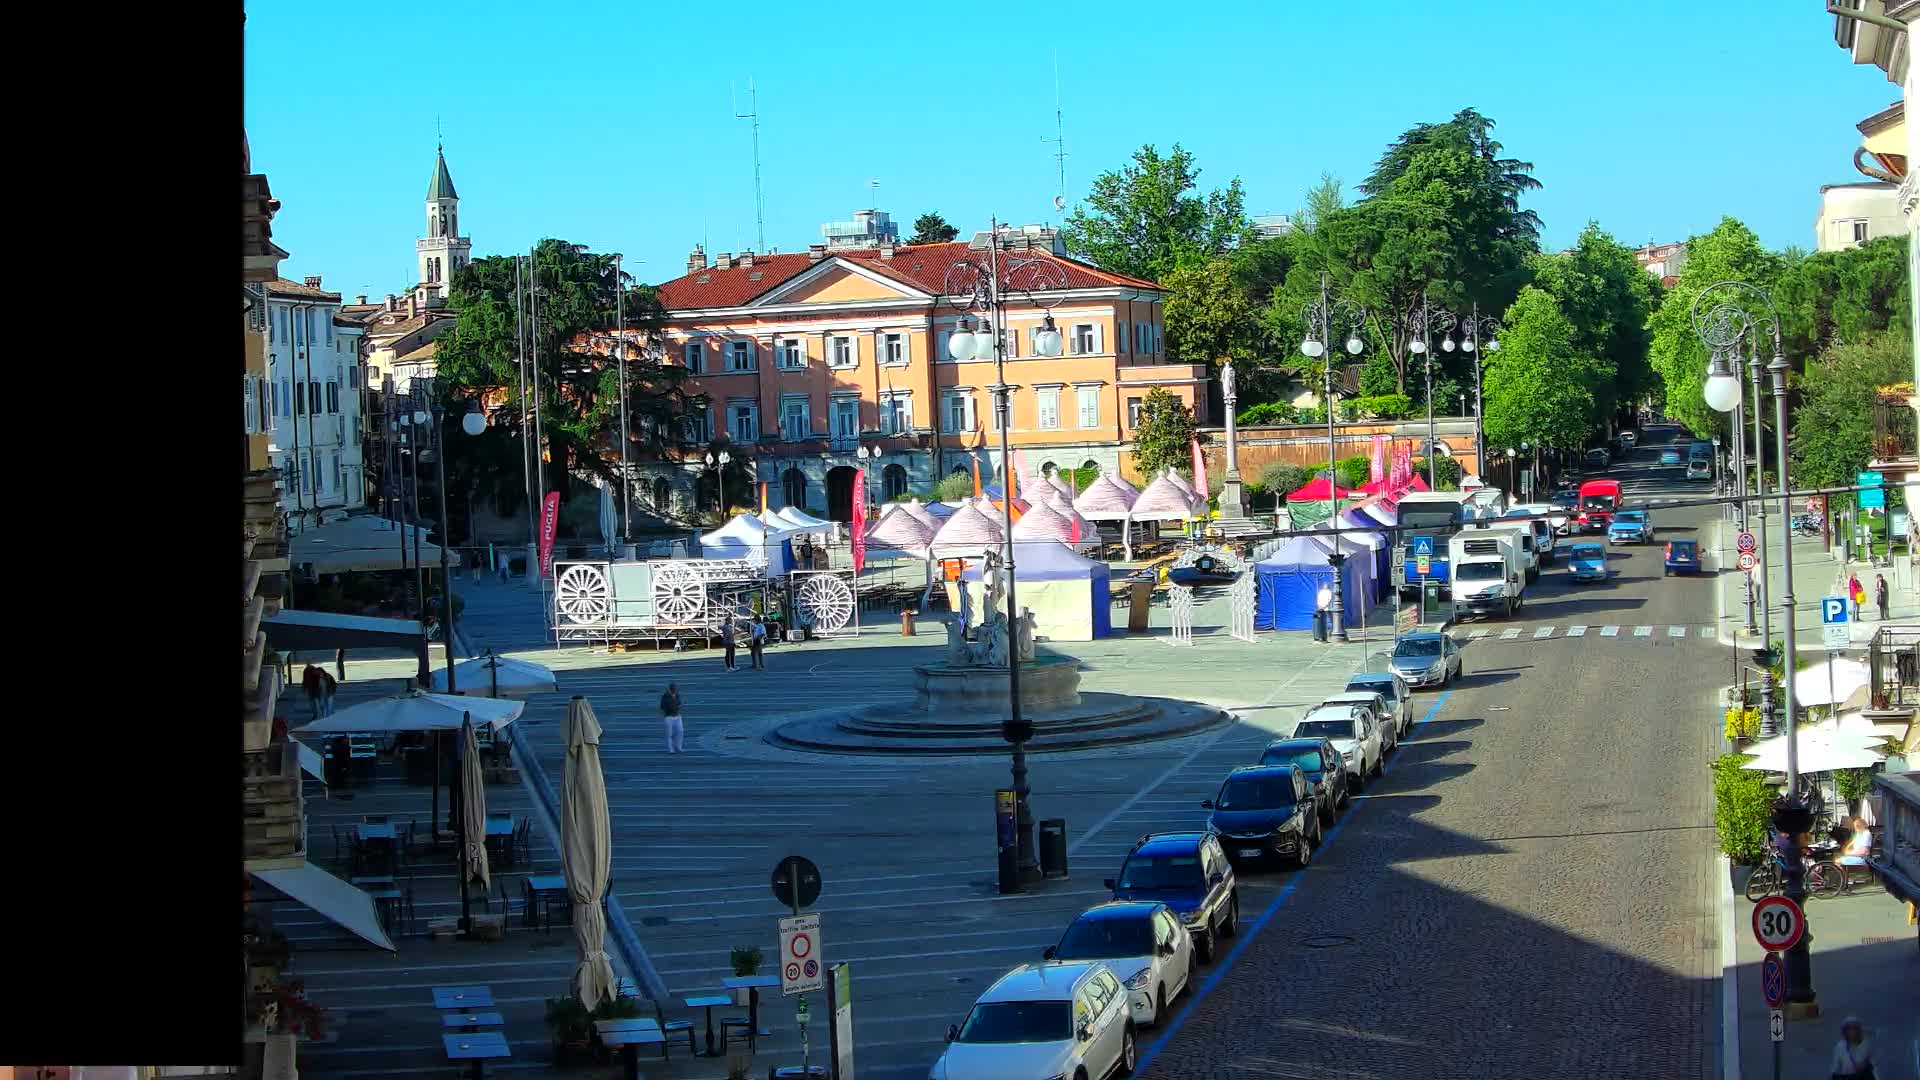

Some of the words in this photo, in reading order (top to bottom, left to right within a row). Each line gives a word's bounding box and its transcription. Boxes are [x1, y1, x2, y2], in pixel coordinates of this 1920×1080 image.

[544, 500, 554, 540] PUGLIA
[1742, 557, 1752, 566] 20
[1826, 600, 1842, 621] P
[1762, 910, 1792, 937] 30
[788, 967, 798, 977] 20
